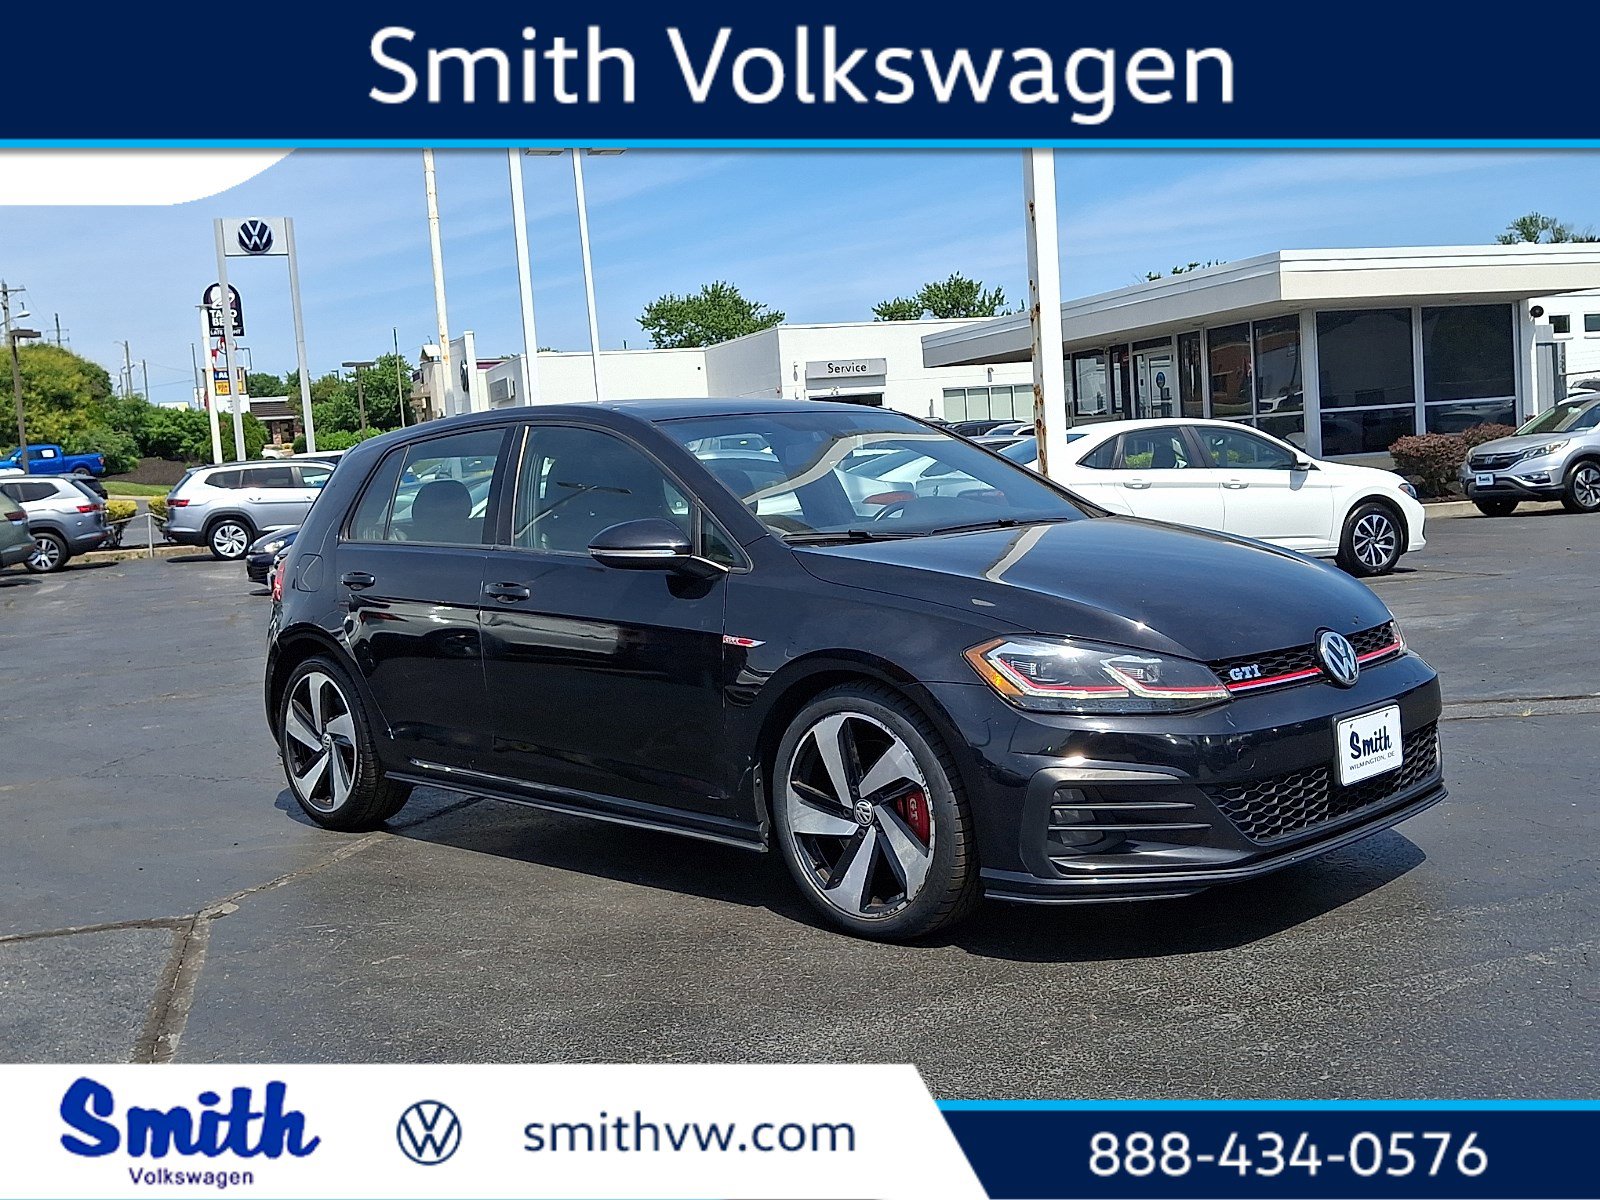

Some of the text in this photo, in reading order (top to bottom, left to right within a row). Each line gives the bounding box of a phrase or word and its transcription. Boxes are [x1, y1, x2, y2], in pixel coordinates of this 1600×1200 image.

[209, 309, 238, 318] TAO
[212, 317, 238, 326] BEL
[827, 363, 867, 374] Service
[1229, 664, 1262, 681] GTI
[1350, 725, 1393, 759] Smith
[1349, 755, 1386, 771] WILMINGTON,
